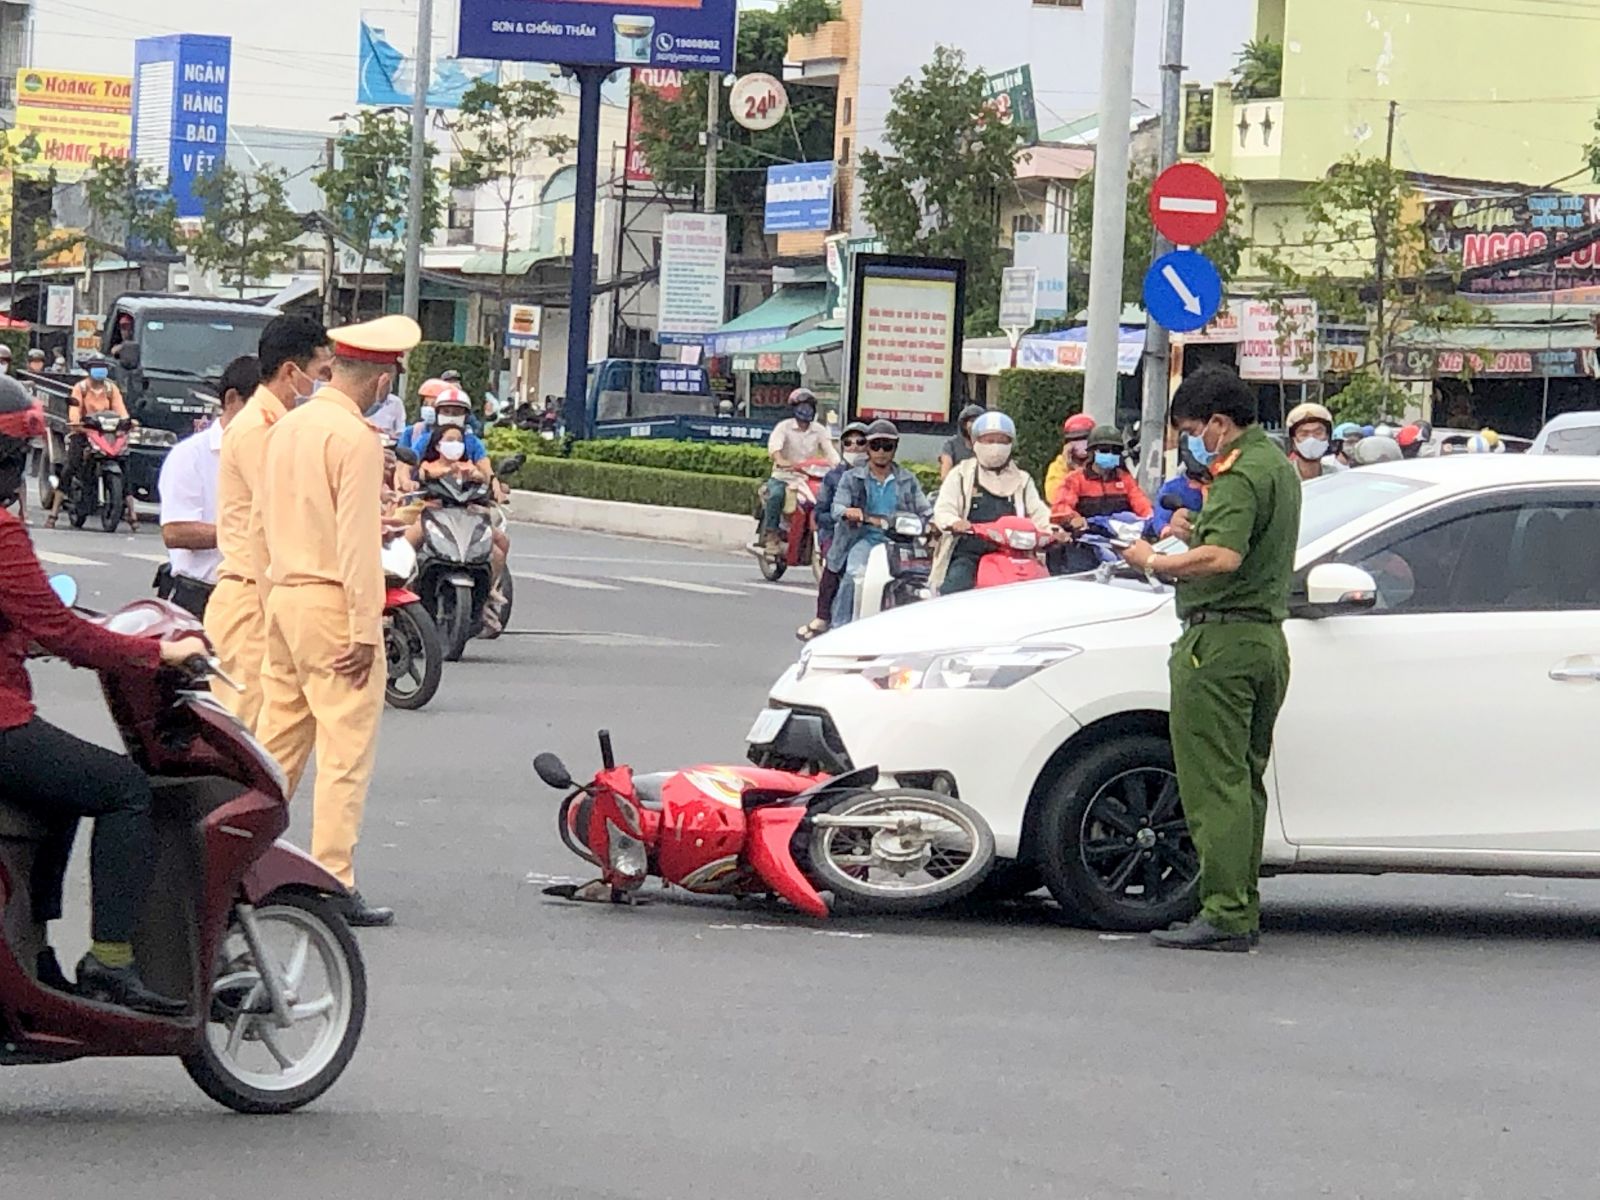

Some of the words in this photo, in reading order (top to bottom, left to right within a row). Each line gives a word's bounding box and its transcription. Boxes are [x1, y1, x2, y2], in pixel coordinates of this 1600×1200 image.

[516, 22, 524, 33] &
[526, 21, 563, 36] CHỐNG
[184, 60, 226, 84] NGÂN
[183, 90, 223, 115] HÀNG
[745, 89, 776, 119] 24h
[186, 117, 217, 144] BẢO
